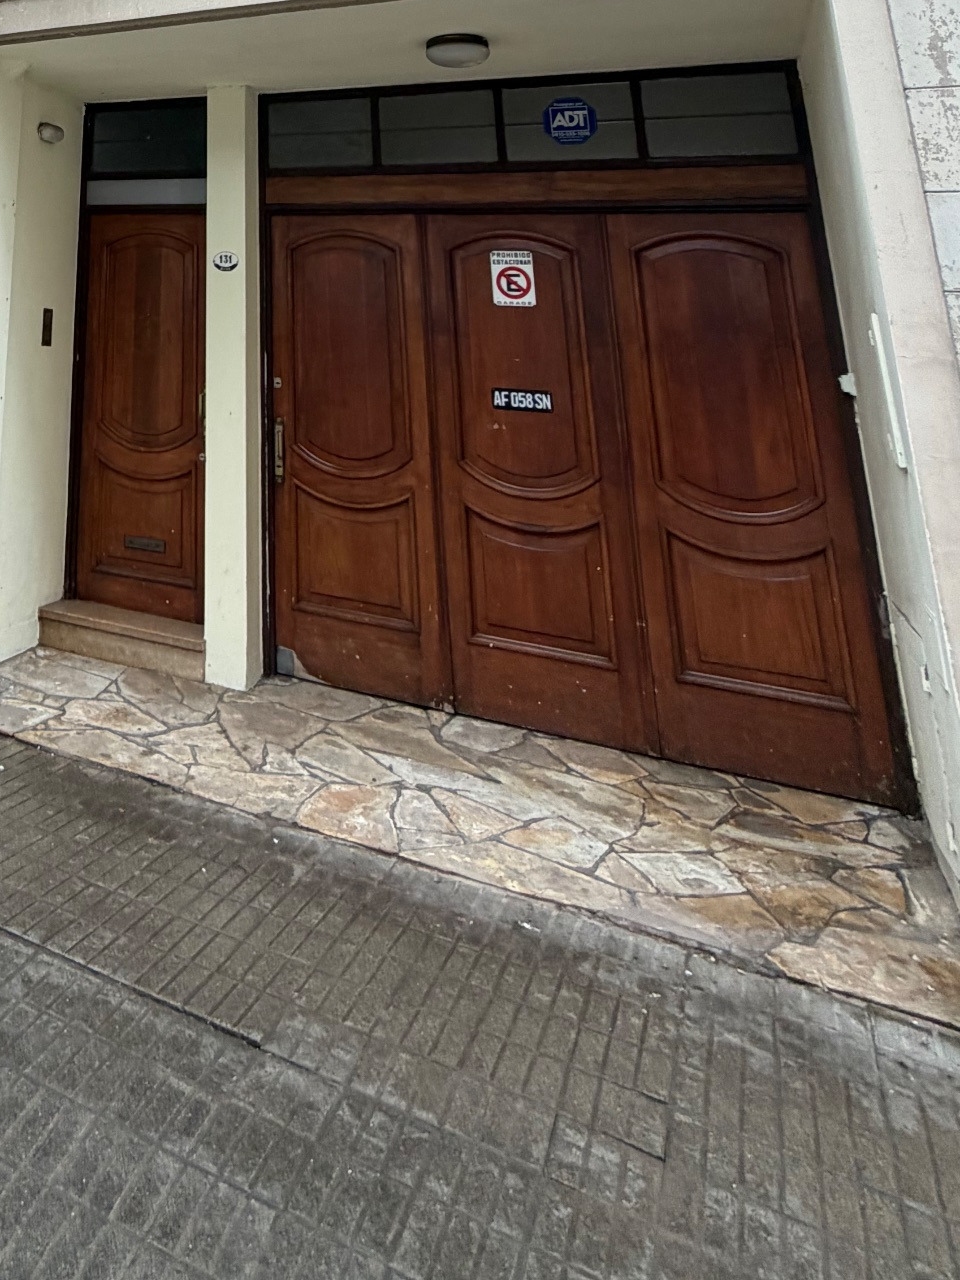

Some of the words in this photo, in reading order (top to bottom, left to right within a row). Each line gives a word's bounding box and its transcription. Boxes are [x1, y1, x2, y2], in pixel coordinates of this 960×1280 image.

[552, 110, 588, 128] ADT
[219, 254, 233, 264] 131
[493, 390, 509, 407] AF
[510, 391, 534, 409] 058
[534, 393, 552, 410] SN
